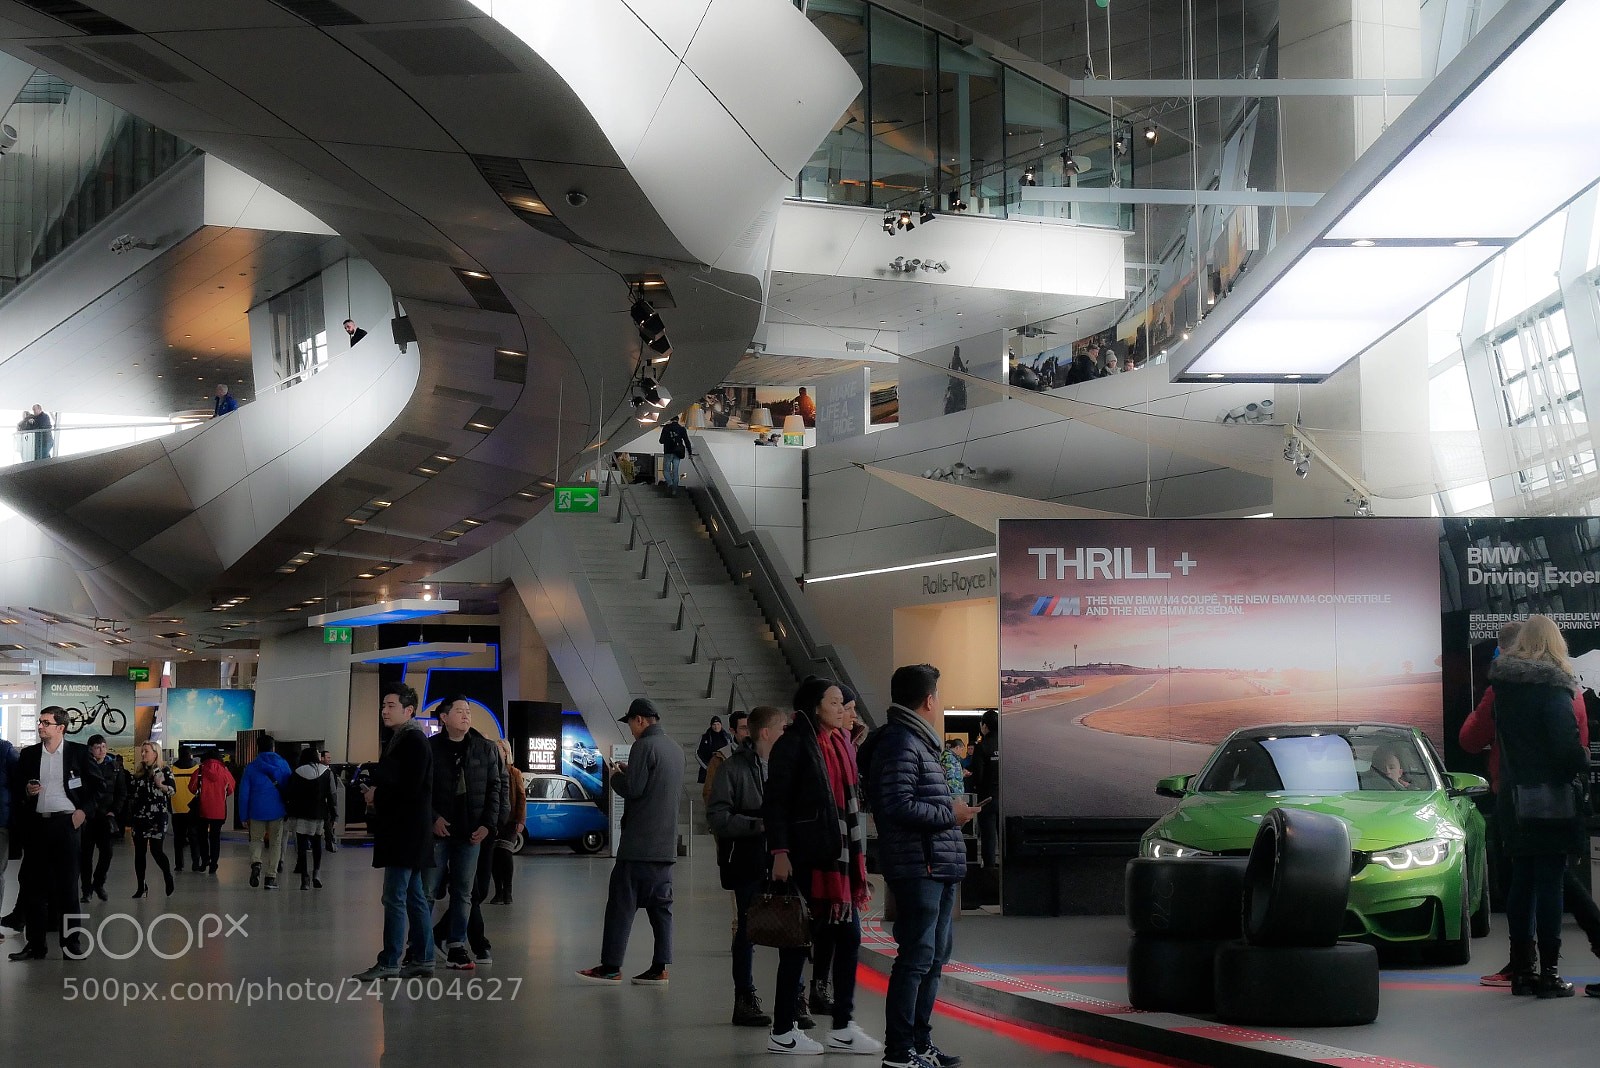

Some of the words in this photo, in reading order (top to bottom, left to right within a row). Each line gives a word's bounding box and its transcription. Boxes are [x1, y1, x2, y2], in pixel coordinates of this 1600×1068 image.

[1467, 547, 1520, 565] BMW
[1028, 547, 1171, 580] THRILL
[922, 571, 986, 596] Rolls-Royce
[1468, 567, 1539, 588] Driving
[1086, 596, 1107, 605] THE
[1109, 596, 1134, 605] NEW
[1135, 596, 1163, 605] BMW
[1164, 595, 1179, 605] M4
[1222, 595, 1244, 604] THE
[1246, 595, 1270, 604] NEW
[1271, 595, 1299, 604] BMW
[1300, 595, 1316, 604] M4
[1317, 594, 1392, 604] CONVERTIBLE
[1085, 607, 1108, 616] AND
[1110, 607, 1132, 616] THE
[1134, 607, 1159, 616] NEW
[1160, 607, 1187, 616] BMW
[1189, 607, 1205, 615] M3
[1206, 606, 1245, 615] SEDAN.
[1469, 613, 1511, 622] ERLEBEN
[1513, 613, 1528, 622] SIE
[1558, 621, 1593, 630] DRIVING
[51, 684, 62, 692] ON
[529, 737, 557, 751] BUSINESS
